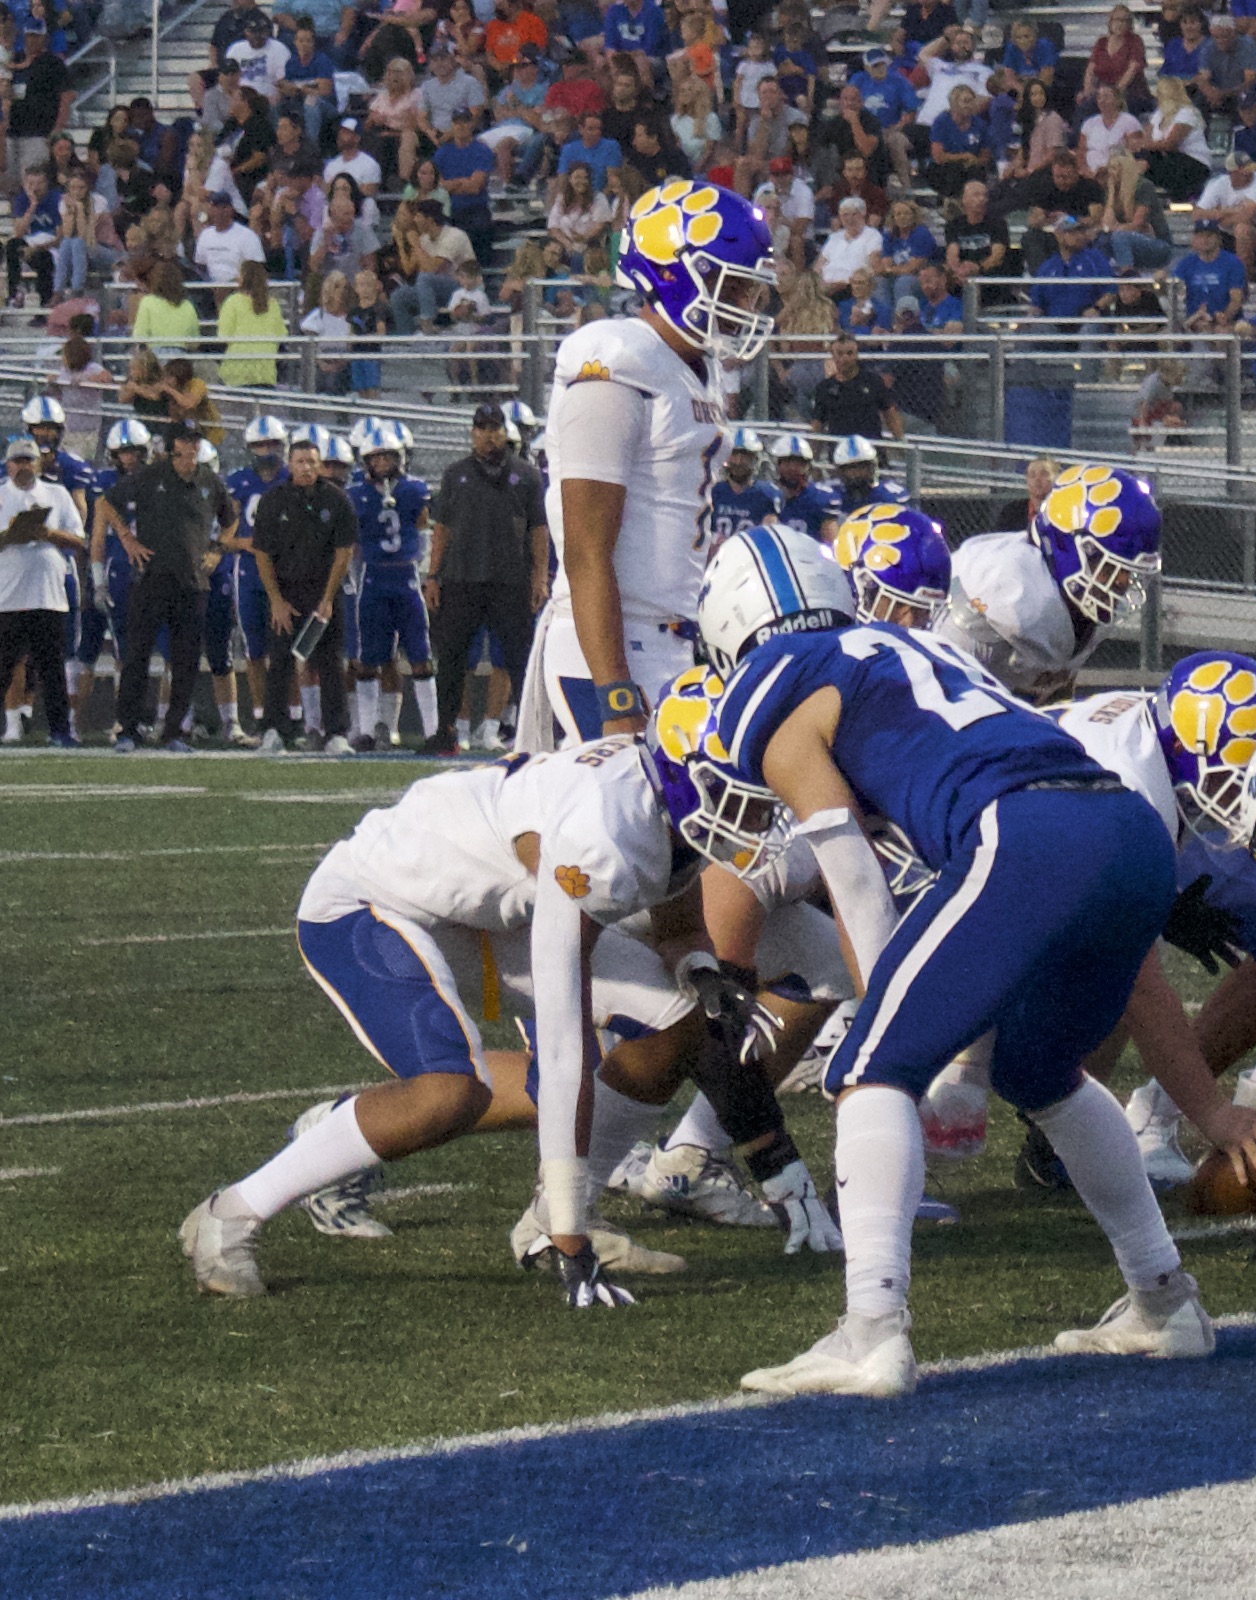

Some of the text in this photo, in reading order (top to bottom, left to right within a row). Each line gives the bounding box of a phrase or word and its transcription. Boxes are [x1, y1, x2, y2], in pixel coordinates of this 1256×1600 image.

[377, 510, 402, 553] 3
[756, 610, 833, 646] Riddell
[608, 688, 634, 712] O
